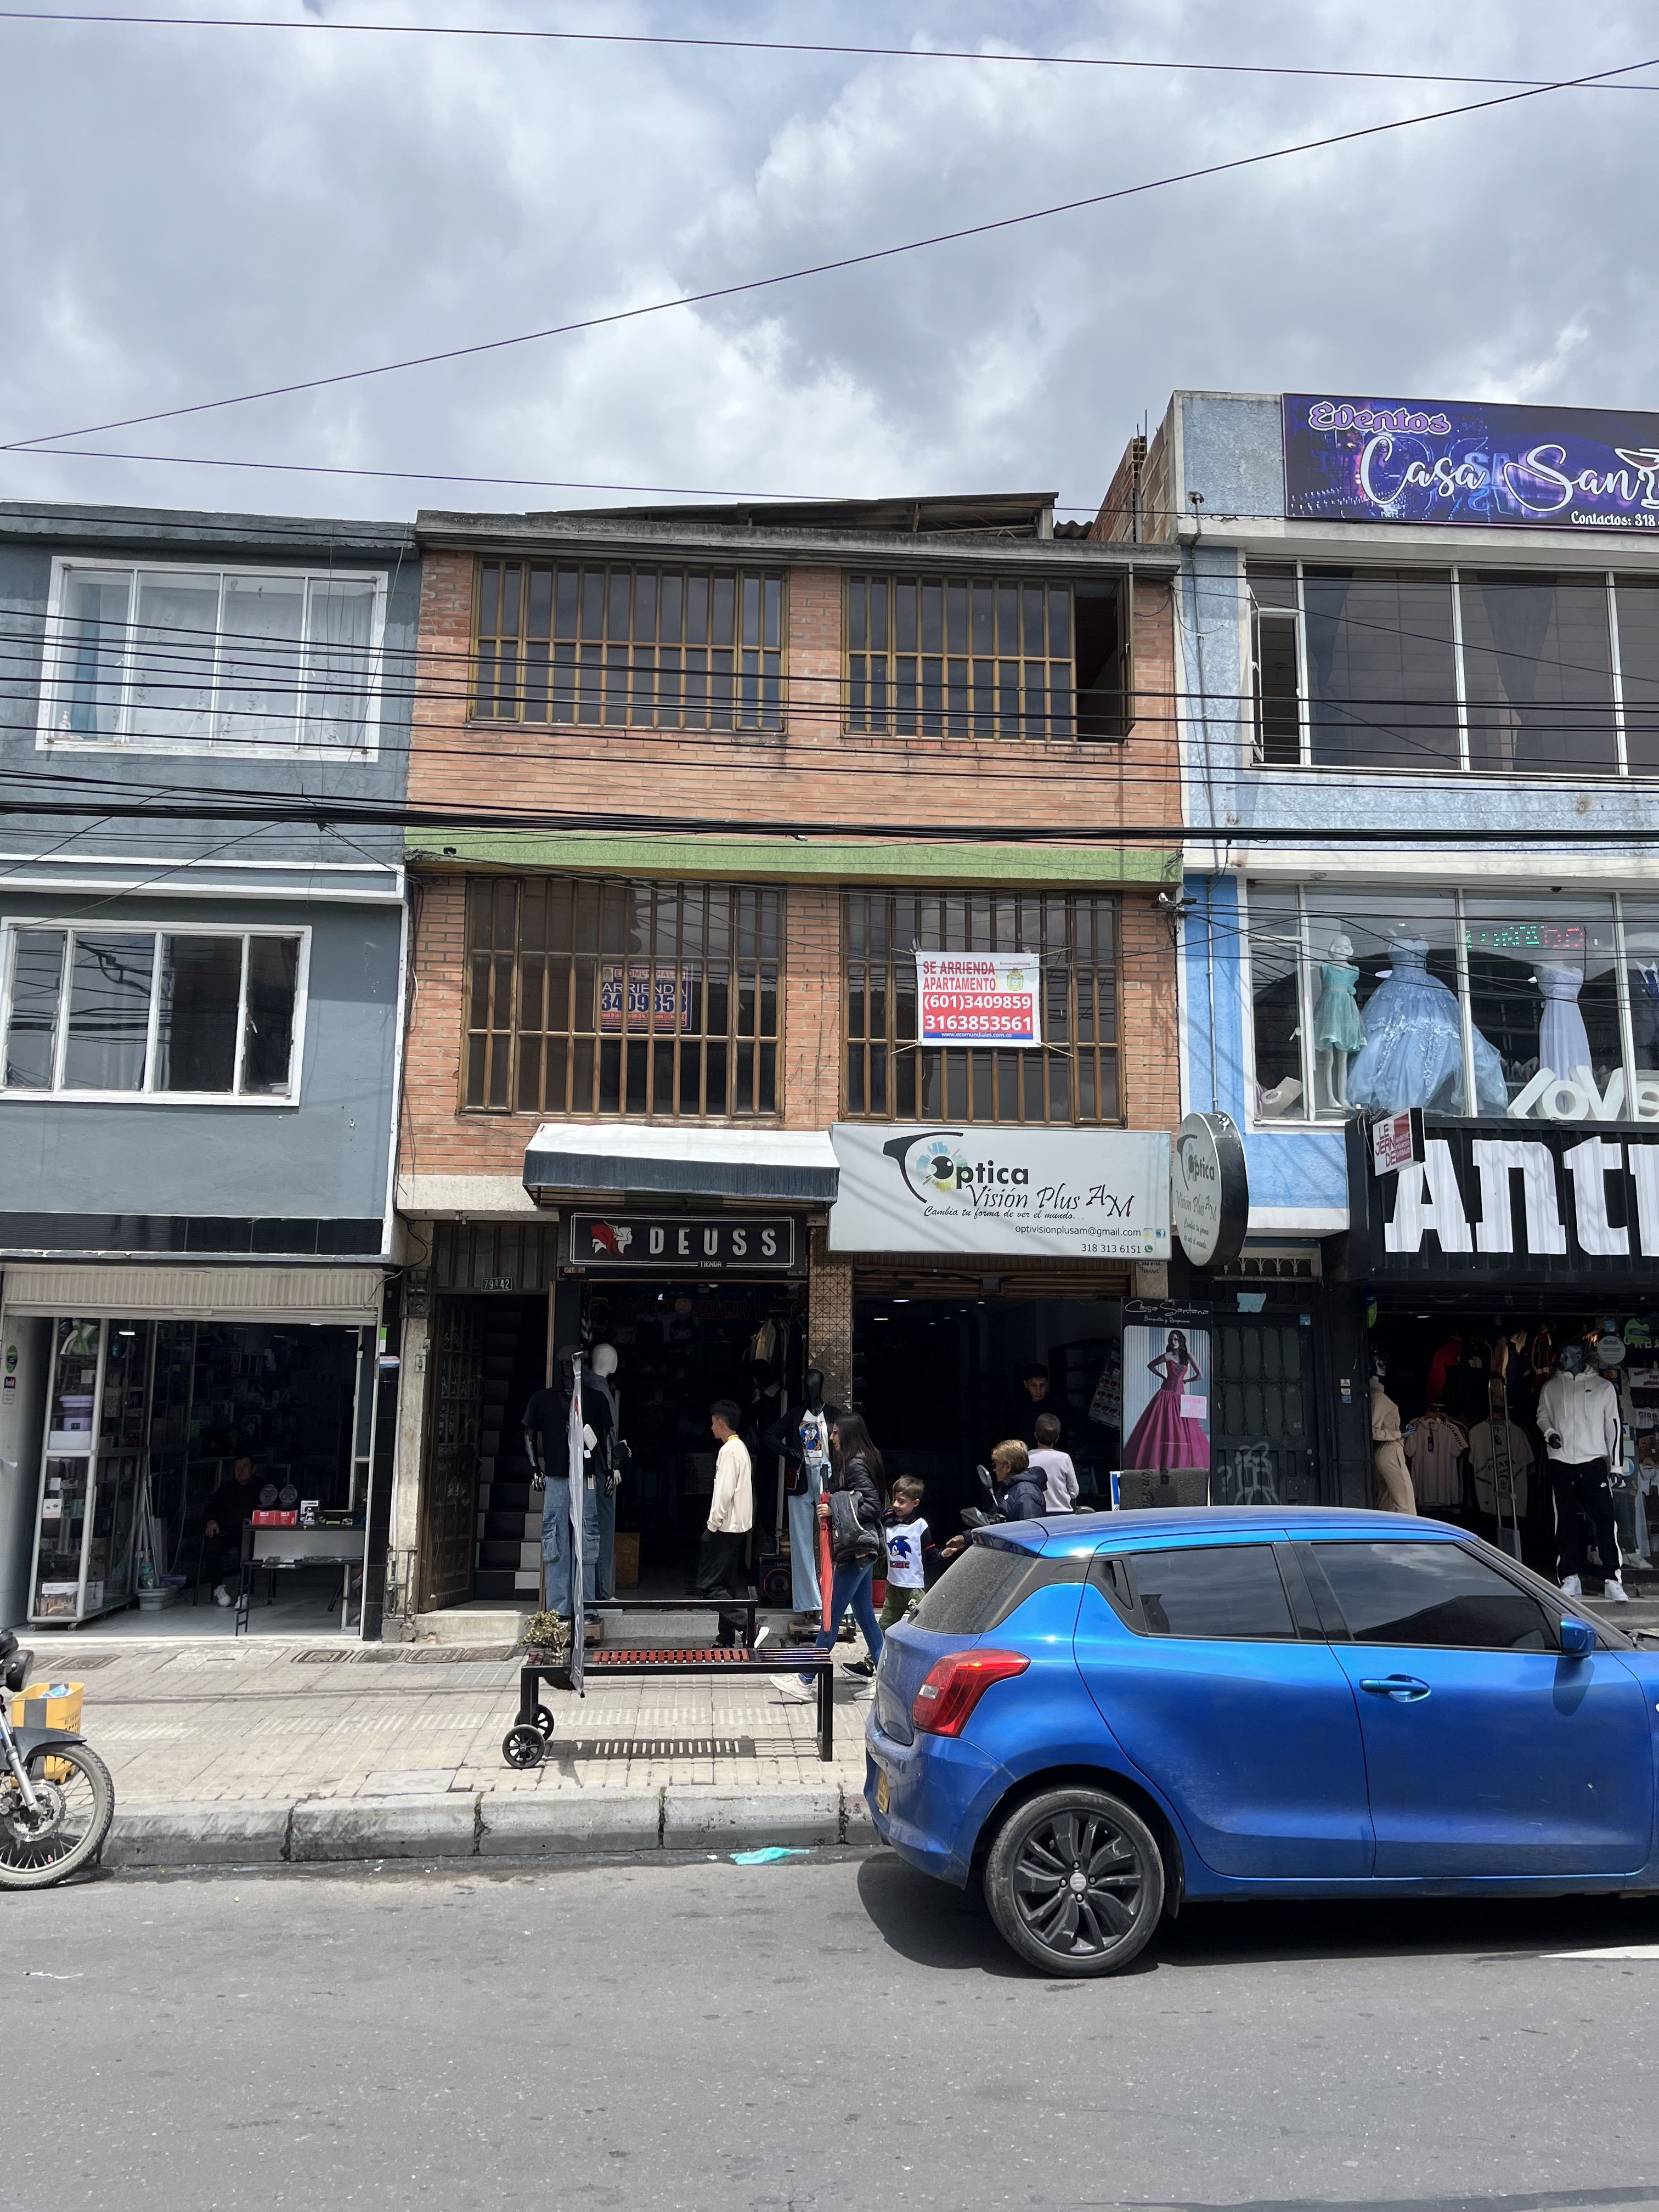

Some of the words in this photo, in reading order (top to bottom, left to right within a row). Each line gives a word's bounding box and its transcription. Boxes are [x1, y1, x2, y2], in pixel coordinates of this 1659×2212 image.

[1361, 435, 1486, 505] Casa
[1571, 510, 1632, 526] Contactos:
[1635, 513, 1656, 527] 318
[923, 961, 936, 974] SE
[940, 961, 996, 975] ARRIENDA
[923, 977, 996, 991] APARTAMENTO
[924, 995, 1031, 1010] (601)3409859
[925, 1015, 1031, 1031] 3163853561
[1379, 1123, 1389, 1140] LE
[1375, 1135, 1395, 1156] JEAN
[1385, 1150, 1396, 1167] DE
[966, 1184, 1029, 1208] Visión
[1036, 1183, 1081, 1210] Plus
[1085, 1184, 1135, 1217] AM
[1193, 1193, 1204, 1216] Plus
[924, 1205, 958, 1217] Cambia
[974, 1209, 1000, 1220] forma
[1003, 1209, 1014, 1217] de
[1034, 1210, 1041, 1218] el
[1015, 1225, 1142, 1237] optivisionplusam@gmail.com
[649, 1226, 777, 1256] DEUSS
[1081, 1243, 1097, 1252] 318
[1101, 1244, 1116, 1253] 313
[1120, 1245, 1141, 1254] 6151
[699, 1260, 723, 1268] TIENDA
[484, 1279, 494, 1290] 79
[500, 1279, 510, 1289] 42
[1125, 1300, 1158, 1313] Casa
[1159, 1302, 1209, 1316] Santana
